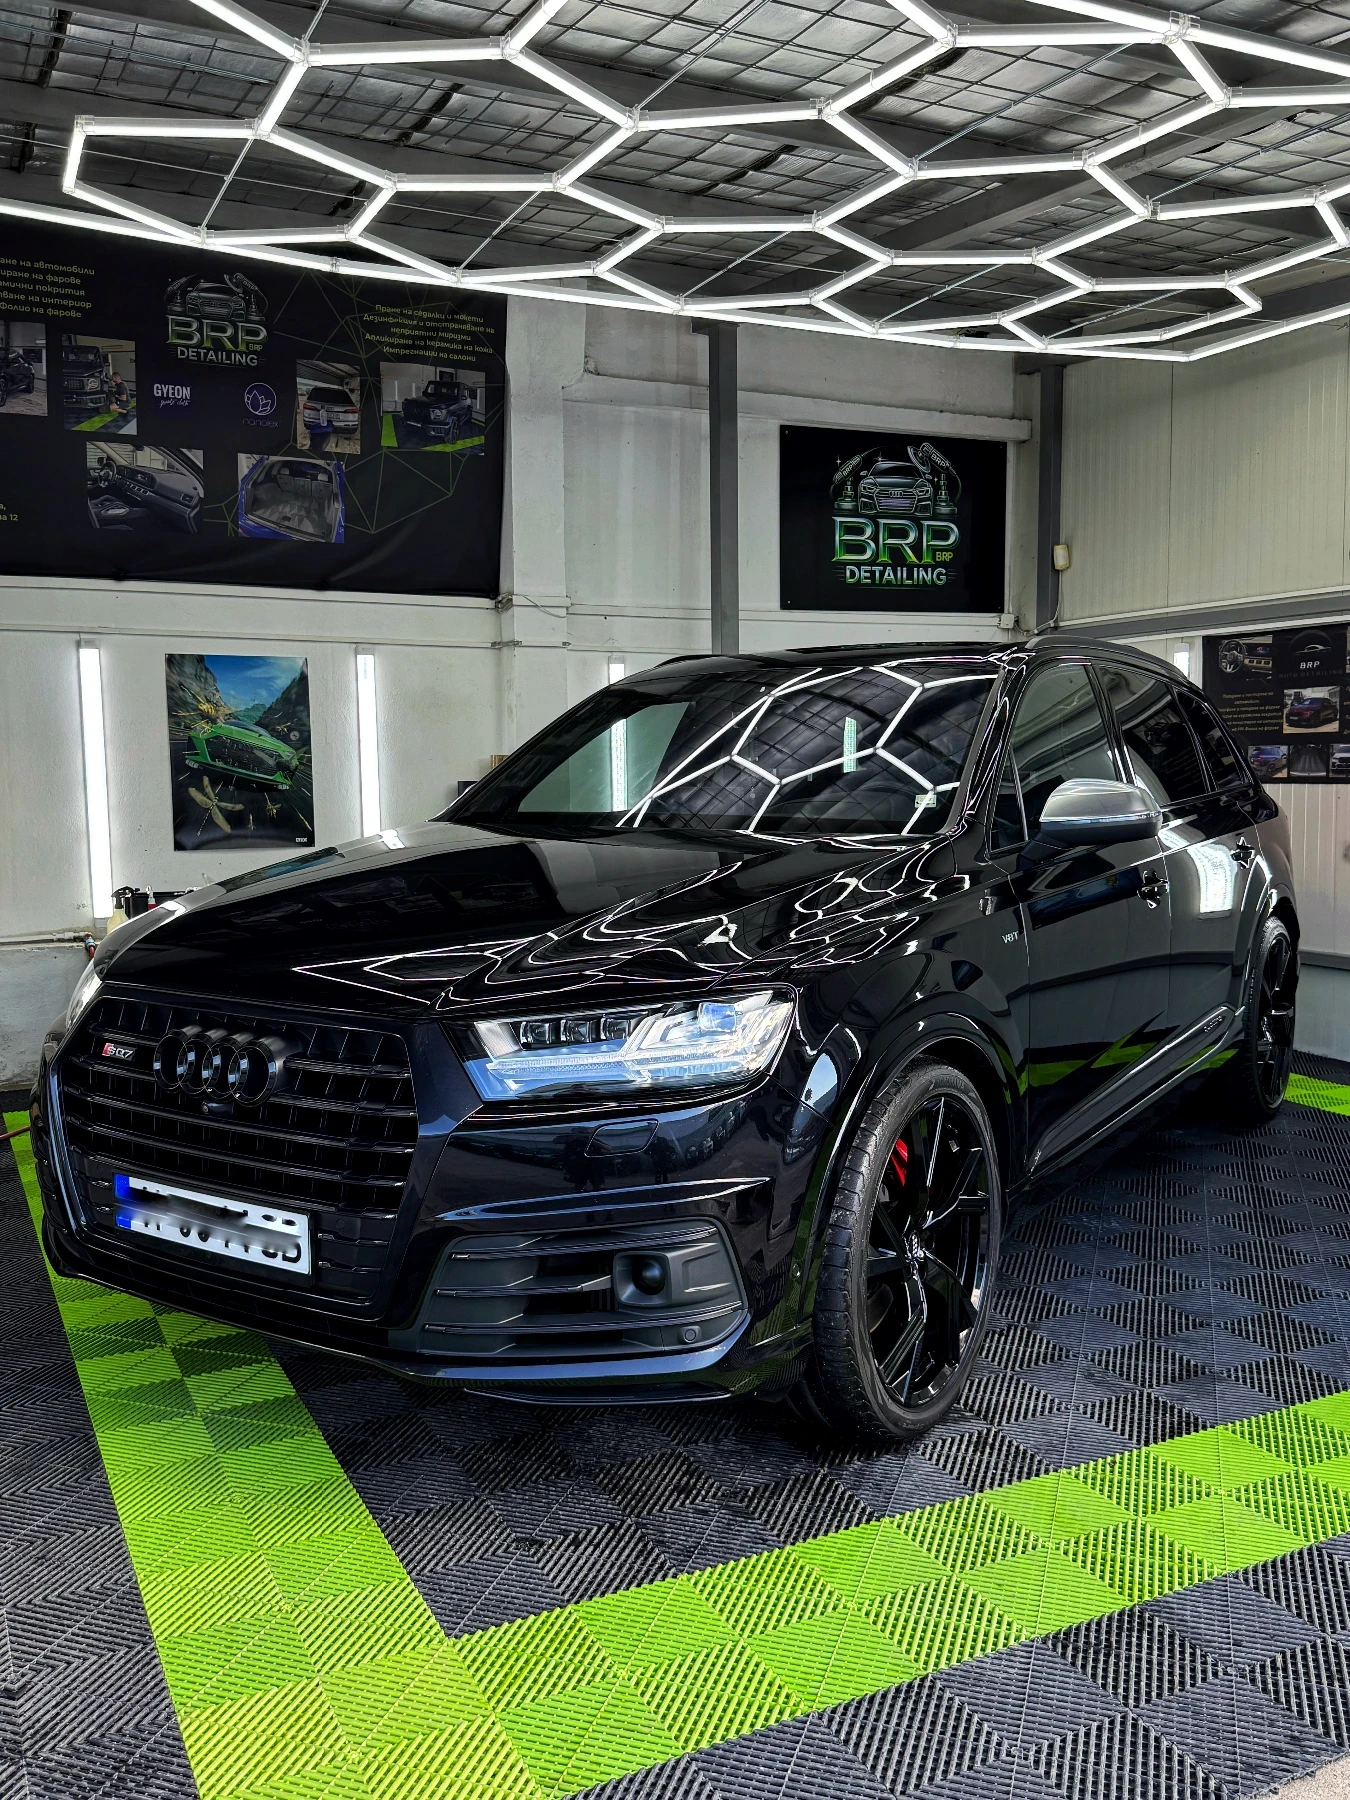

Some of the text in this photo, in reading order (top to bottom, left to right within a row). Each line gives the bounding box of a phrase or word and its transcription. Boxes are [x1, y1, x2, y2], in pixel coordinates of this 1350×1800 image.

[34, 261, 95, 275] автомобили
[46, 273, 81, 285] фарове
[36, 285, 85, 296] покрития
[0, 301, 82, 318] Фолио на фарове
[42, 296, 92, 309] интериор
[375, 304, 401, 314] Пране
[402, 308, 413, 316] на
[414, 309, 445, 320] седалки
[454, 313, 484, 323] мокети
[363, 313, 418, 326] Дезинфекция
[425, 320, 485, 333] отстраняване
[166, 315, 268, 352] BRP
[391, 326, 471, 341] неприятни миризми
[249, 343, 263, 351] BRP
[365, 332, 413, 345] Апликиране
[426, 339, 462, 351] керамика
[177, 346, 258, 366] DETAILING
[383, 345, 476, 362] Импрегнации на салони
[153, 383, 191, 400] GYEON
[243, 418, 279, 428] nanolex
[930, 453, 947, 468] BRP
[9, 513, 19, 521] 12
[831, 516, 960, 565] BRP
[936, 551, 954, 562] BRP
[845, 565, 947, 586] DETAILING
[1300, 660, 1320, 669] BRP
[1002, 930, 1019, 944] V8T
[105, 1044, 134, 1059] SQ7
